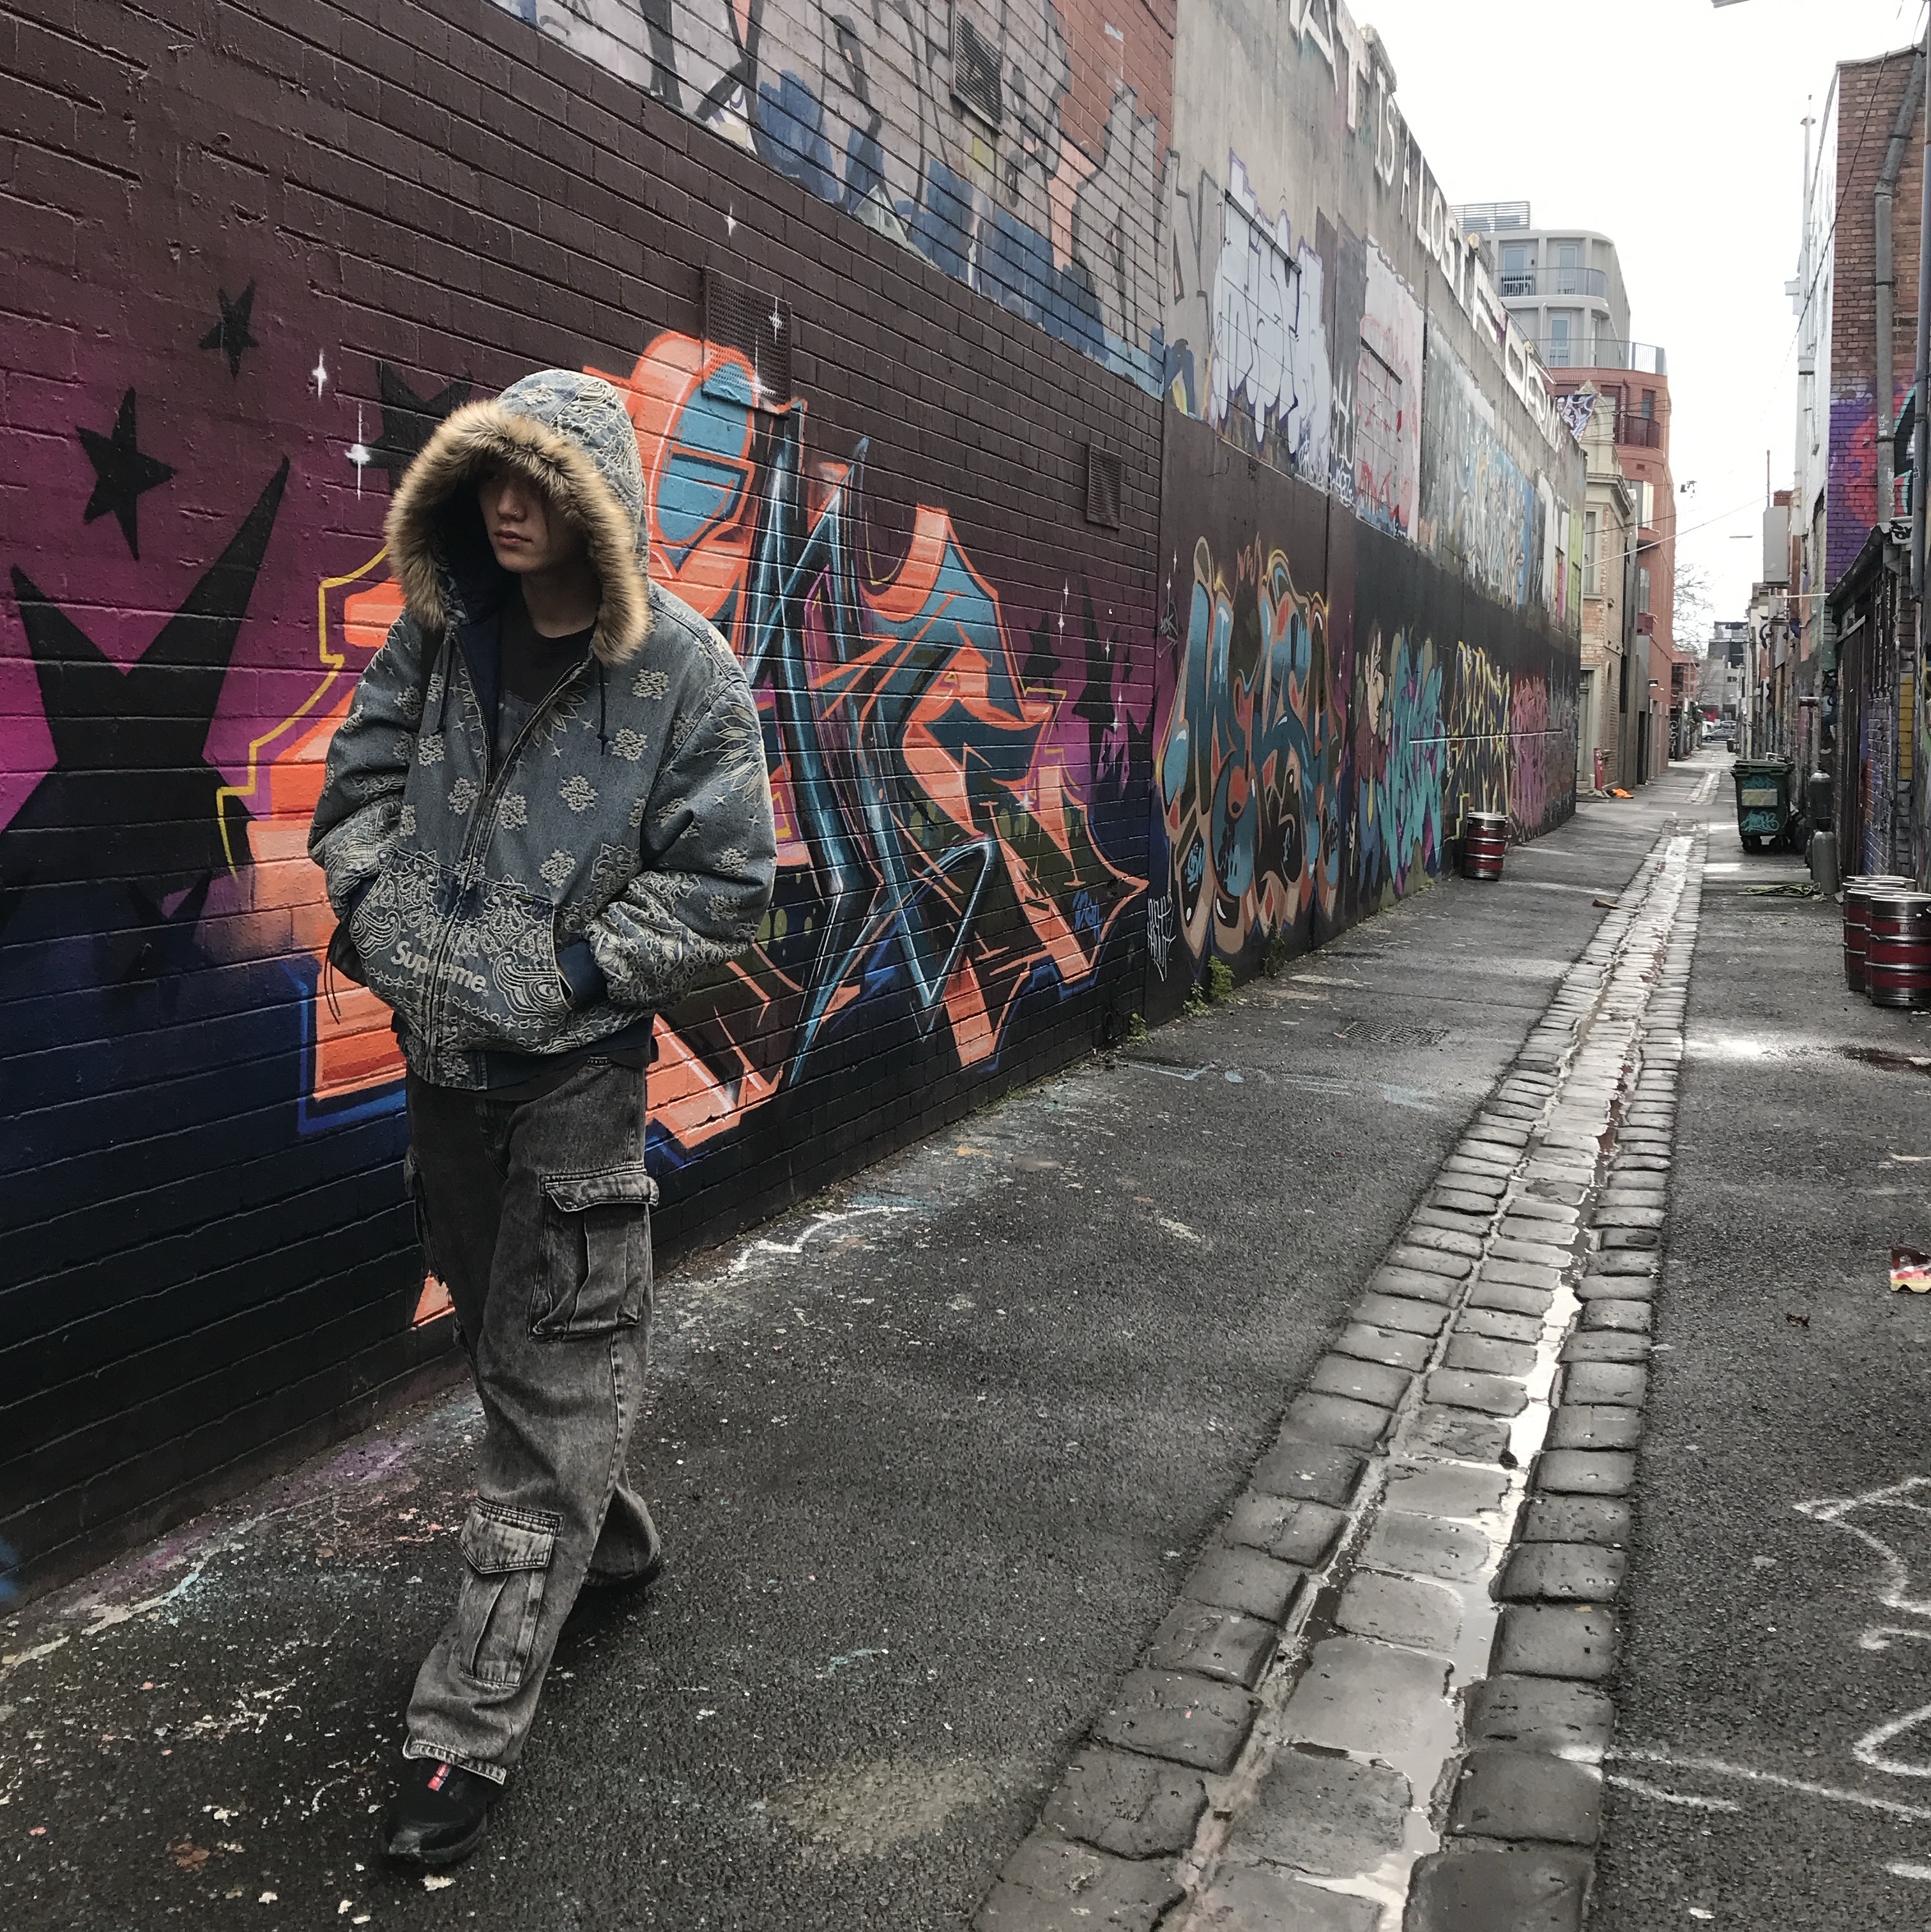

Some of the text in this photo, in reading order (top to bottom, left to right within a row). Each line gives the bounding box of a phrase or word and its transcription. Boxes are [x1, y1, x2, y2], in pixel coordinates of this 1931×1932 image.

[1375, 65, 1396, 186] IS
[1401, 127, 1411, 225] A
[1417, 153, 1469, 308] LOST
[390, 941, 487, 993] Supreme
